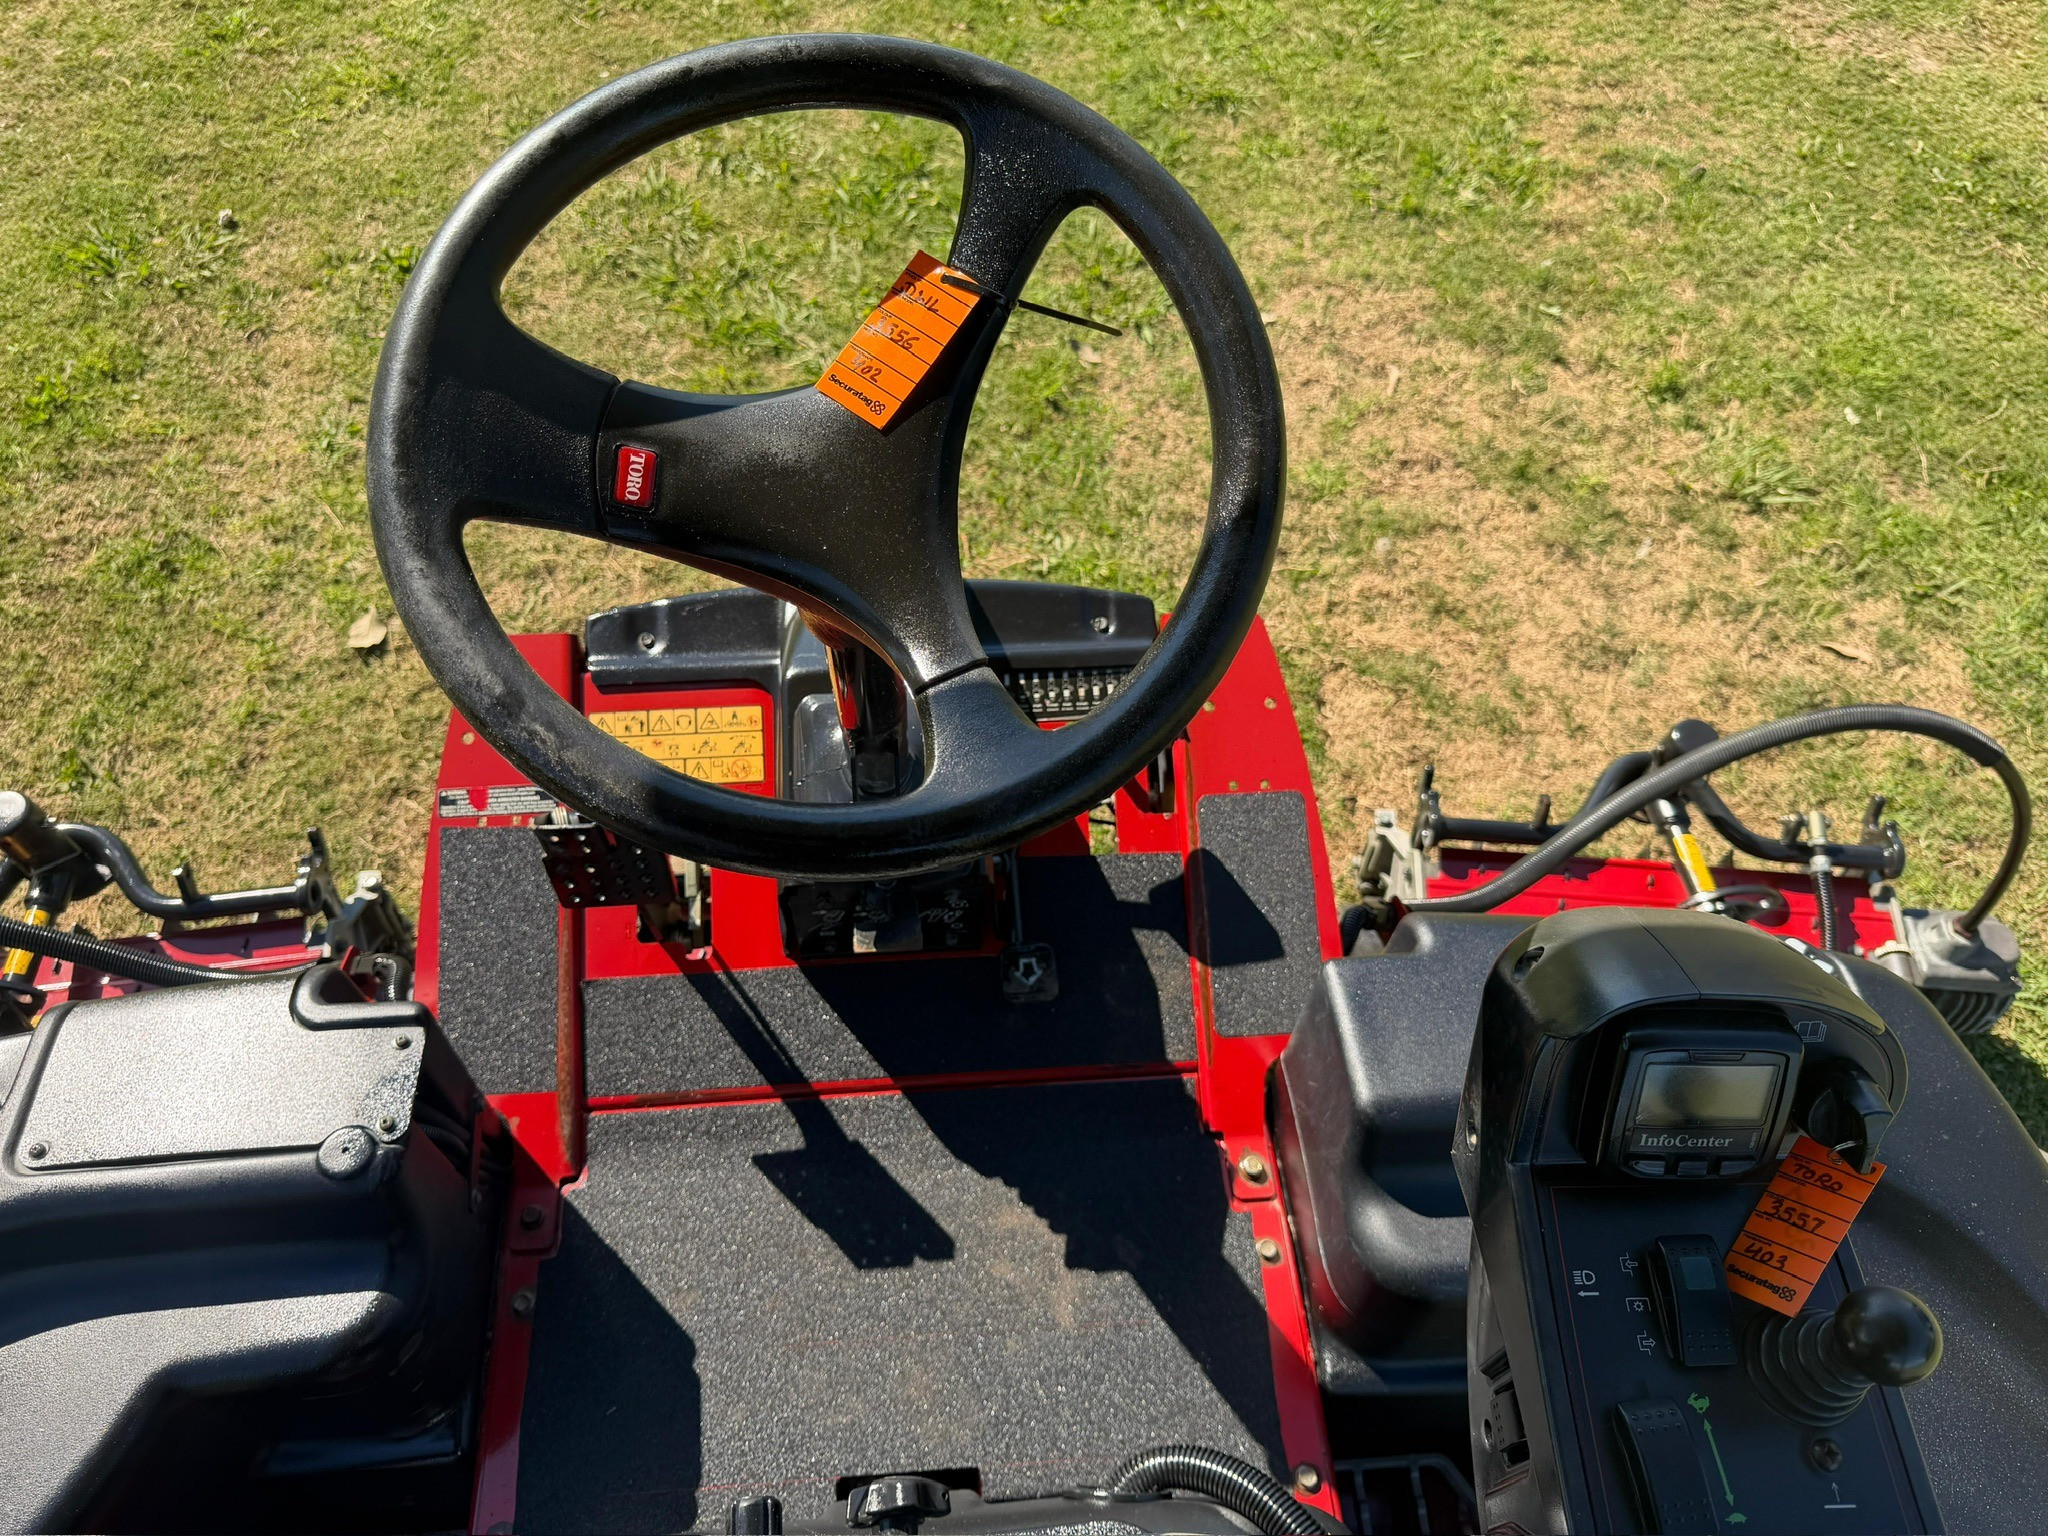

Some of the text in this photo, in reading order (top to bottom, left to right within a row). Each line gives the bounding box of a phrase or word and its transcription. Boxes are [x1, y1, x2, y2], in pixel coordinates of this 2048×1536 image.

[828, 373, 873, 408] Securatag
[625, 453, 646, 501] TORO
[1639, 1133, 1734, 1148] InfoCenter
[1793, 1162, 1843, 1192] TORO
[1763, 1200, 1826, 1233] 3557
[1743, 1242, 1789, 1270] 403
[1726, 1263, 1782, 1294] Securatag
